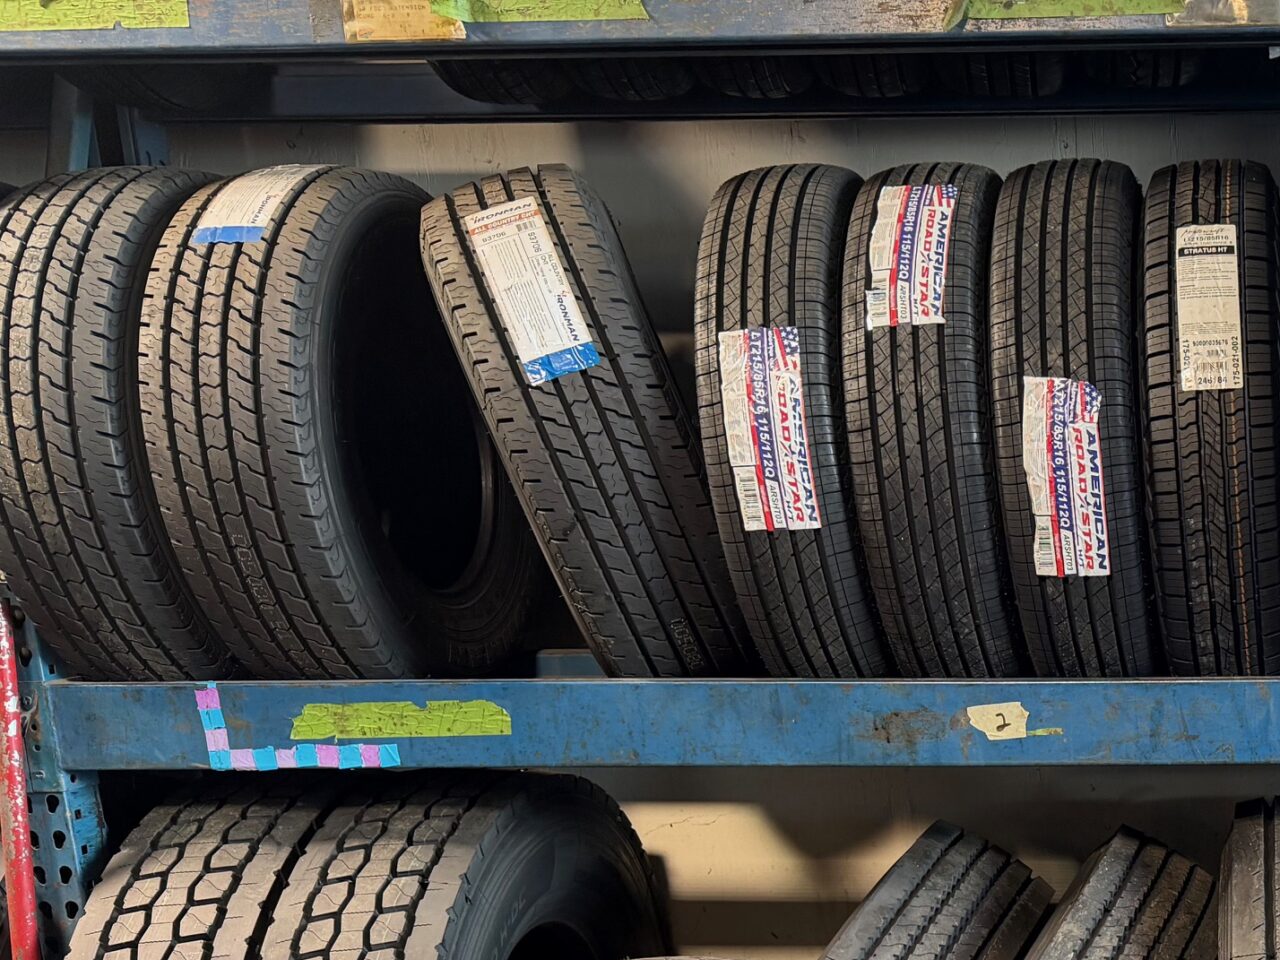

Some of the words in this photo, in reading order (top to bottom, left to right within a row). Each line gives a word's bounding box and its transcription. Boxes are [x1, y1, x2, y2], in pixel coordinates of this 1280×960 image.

[899, 233, 913, 280] 115/112Q
[924, 208, 936, 252] ROAD
[1184, 246, 1216, 254] STRATUS
[930, 210, 949, 316] AMERICAN
[920, 266, 930, 318] STAR
[1232, 336, 1240, 386] 175-021-002
[757, 415, 775, 482] 115/112Q
[776, 375, 792, 443] OAD
[786, 464, 804, 523] STAR
[789, 376, 818, 523] AMERICAN
[768, 484, 783, 525] ARSHT03
[1054, 467, 1070, 528] 115/112Q
[1072, 426, 1088, 494] ROAD
[1082, 511, 1095, 571] STAR
[1086, 429, 1108, 570] AMERICAN
[1064, 534, 1073, 572] ARSHT03
